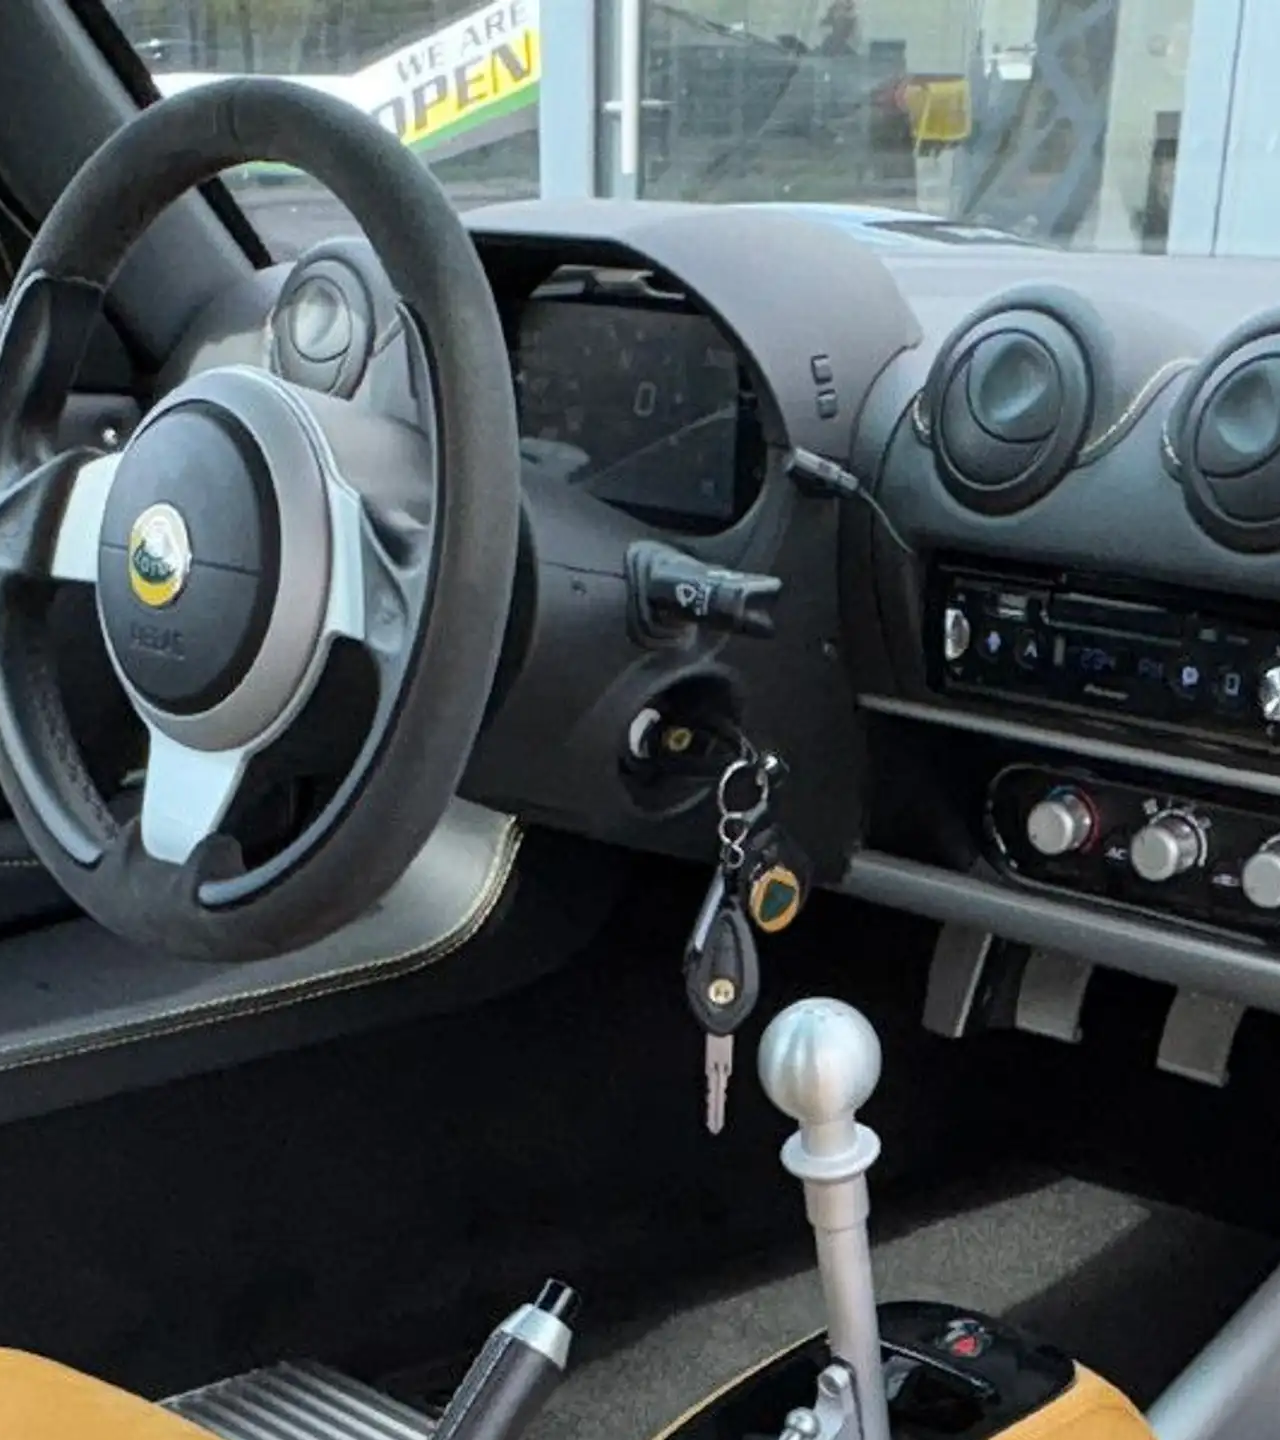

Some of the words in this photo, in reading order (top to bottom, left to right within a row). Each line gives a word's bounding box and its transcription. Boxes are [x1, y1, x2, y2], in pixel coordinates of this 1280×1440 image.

[371, 27, 534, 138] OPEN
[396, 47, 446, 83] WE
[462, 2, 531, 50] ARE
